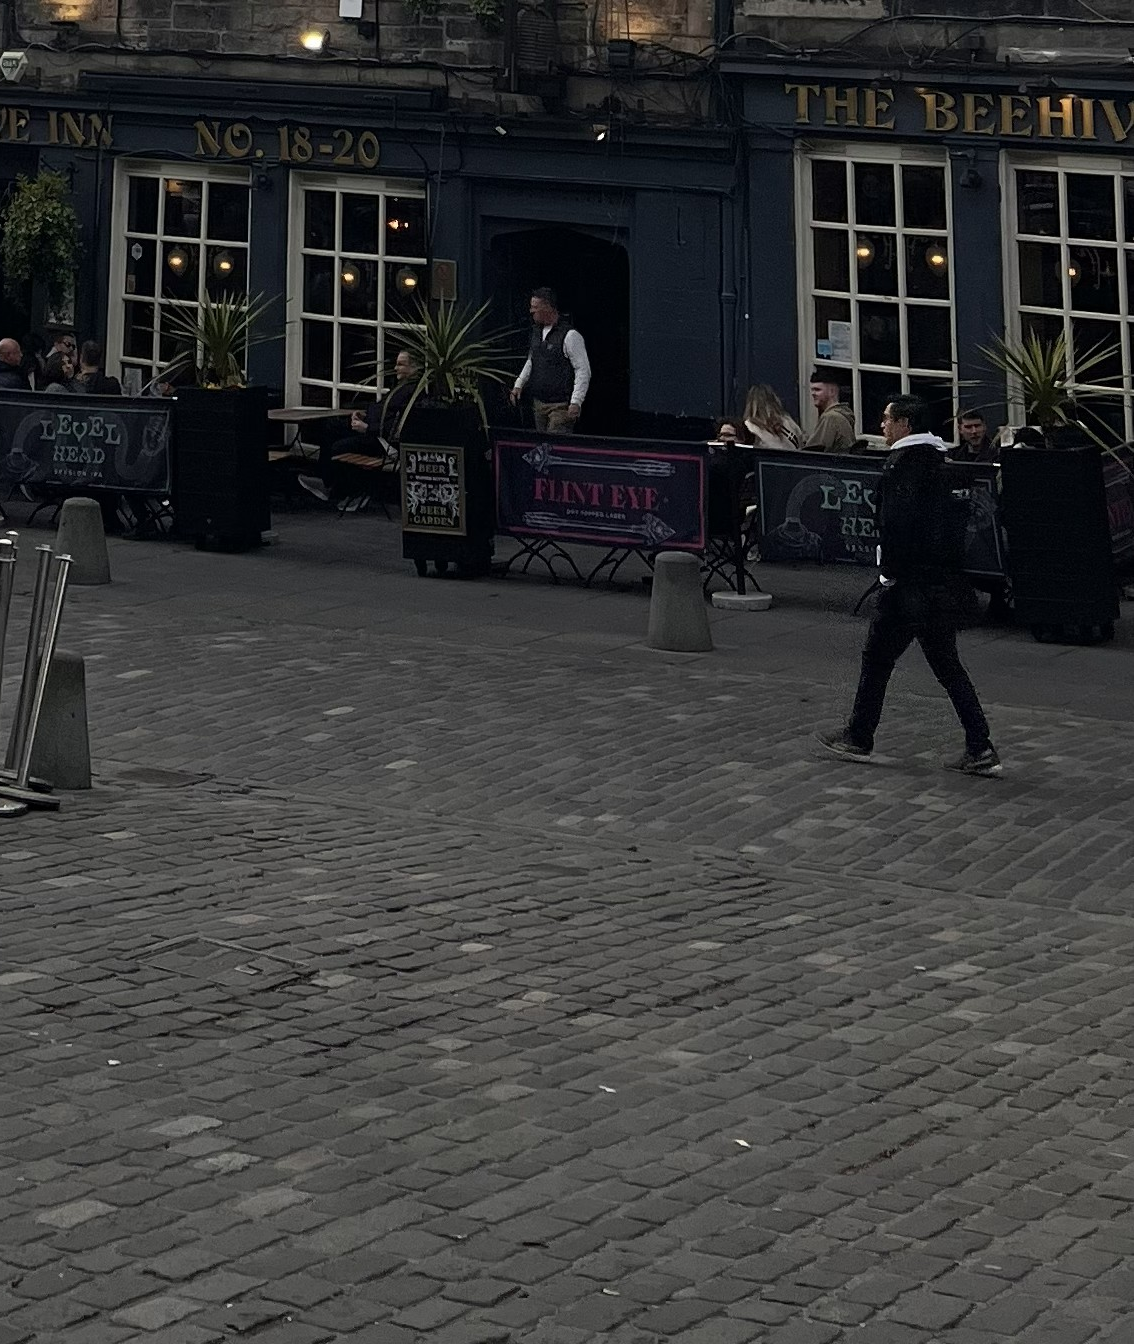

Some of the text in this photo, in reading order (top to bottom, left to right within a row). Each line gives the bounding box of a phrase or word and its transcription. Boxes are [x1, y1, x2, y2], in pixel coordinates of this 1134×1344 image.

[784, 83, 896, 131] THE
[47, 110, 114, 148] INN
[194, 120, 381, 169] NO. 18-20
[40, 413, 121, 445] LEVEL
[53, 445, 106, 464] HEAD
[533, 477, 660, 511] FLINT EYE
[820, 479, 877, 514] LEV
[413, 515, 454, 526] GARDEN
[840, 517, 880, 538] HE
